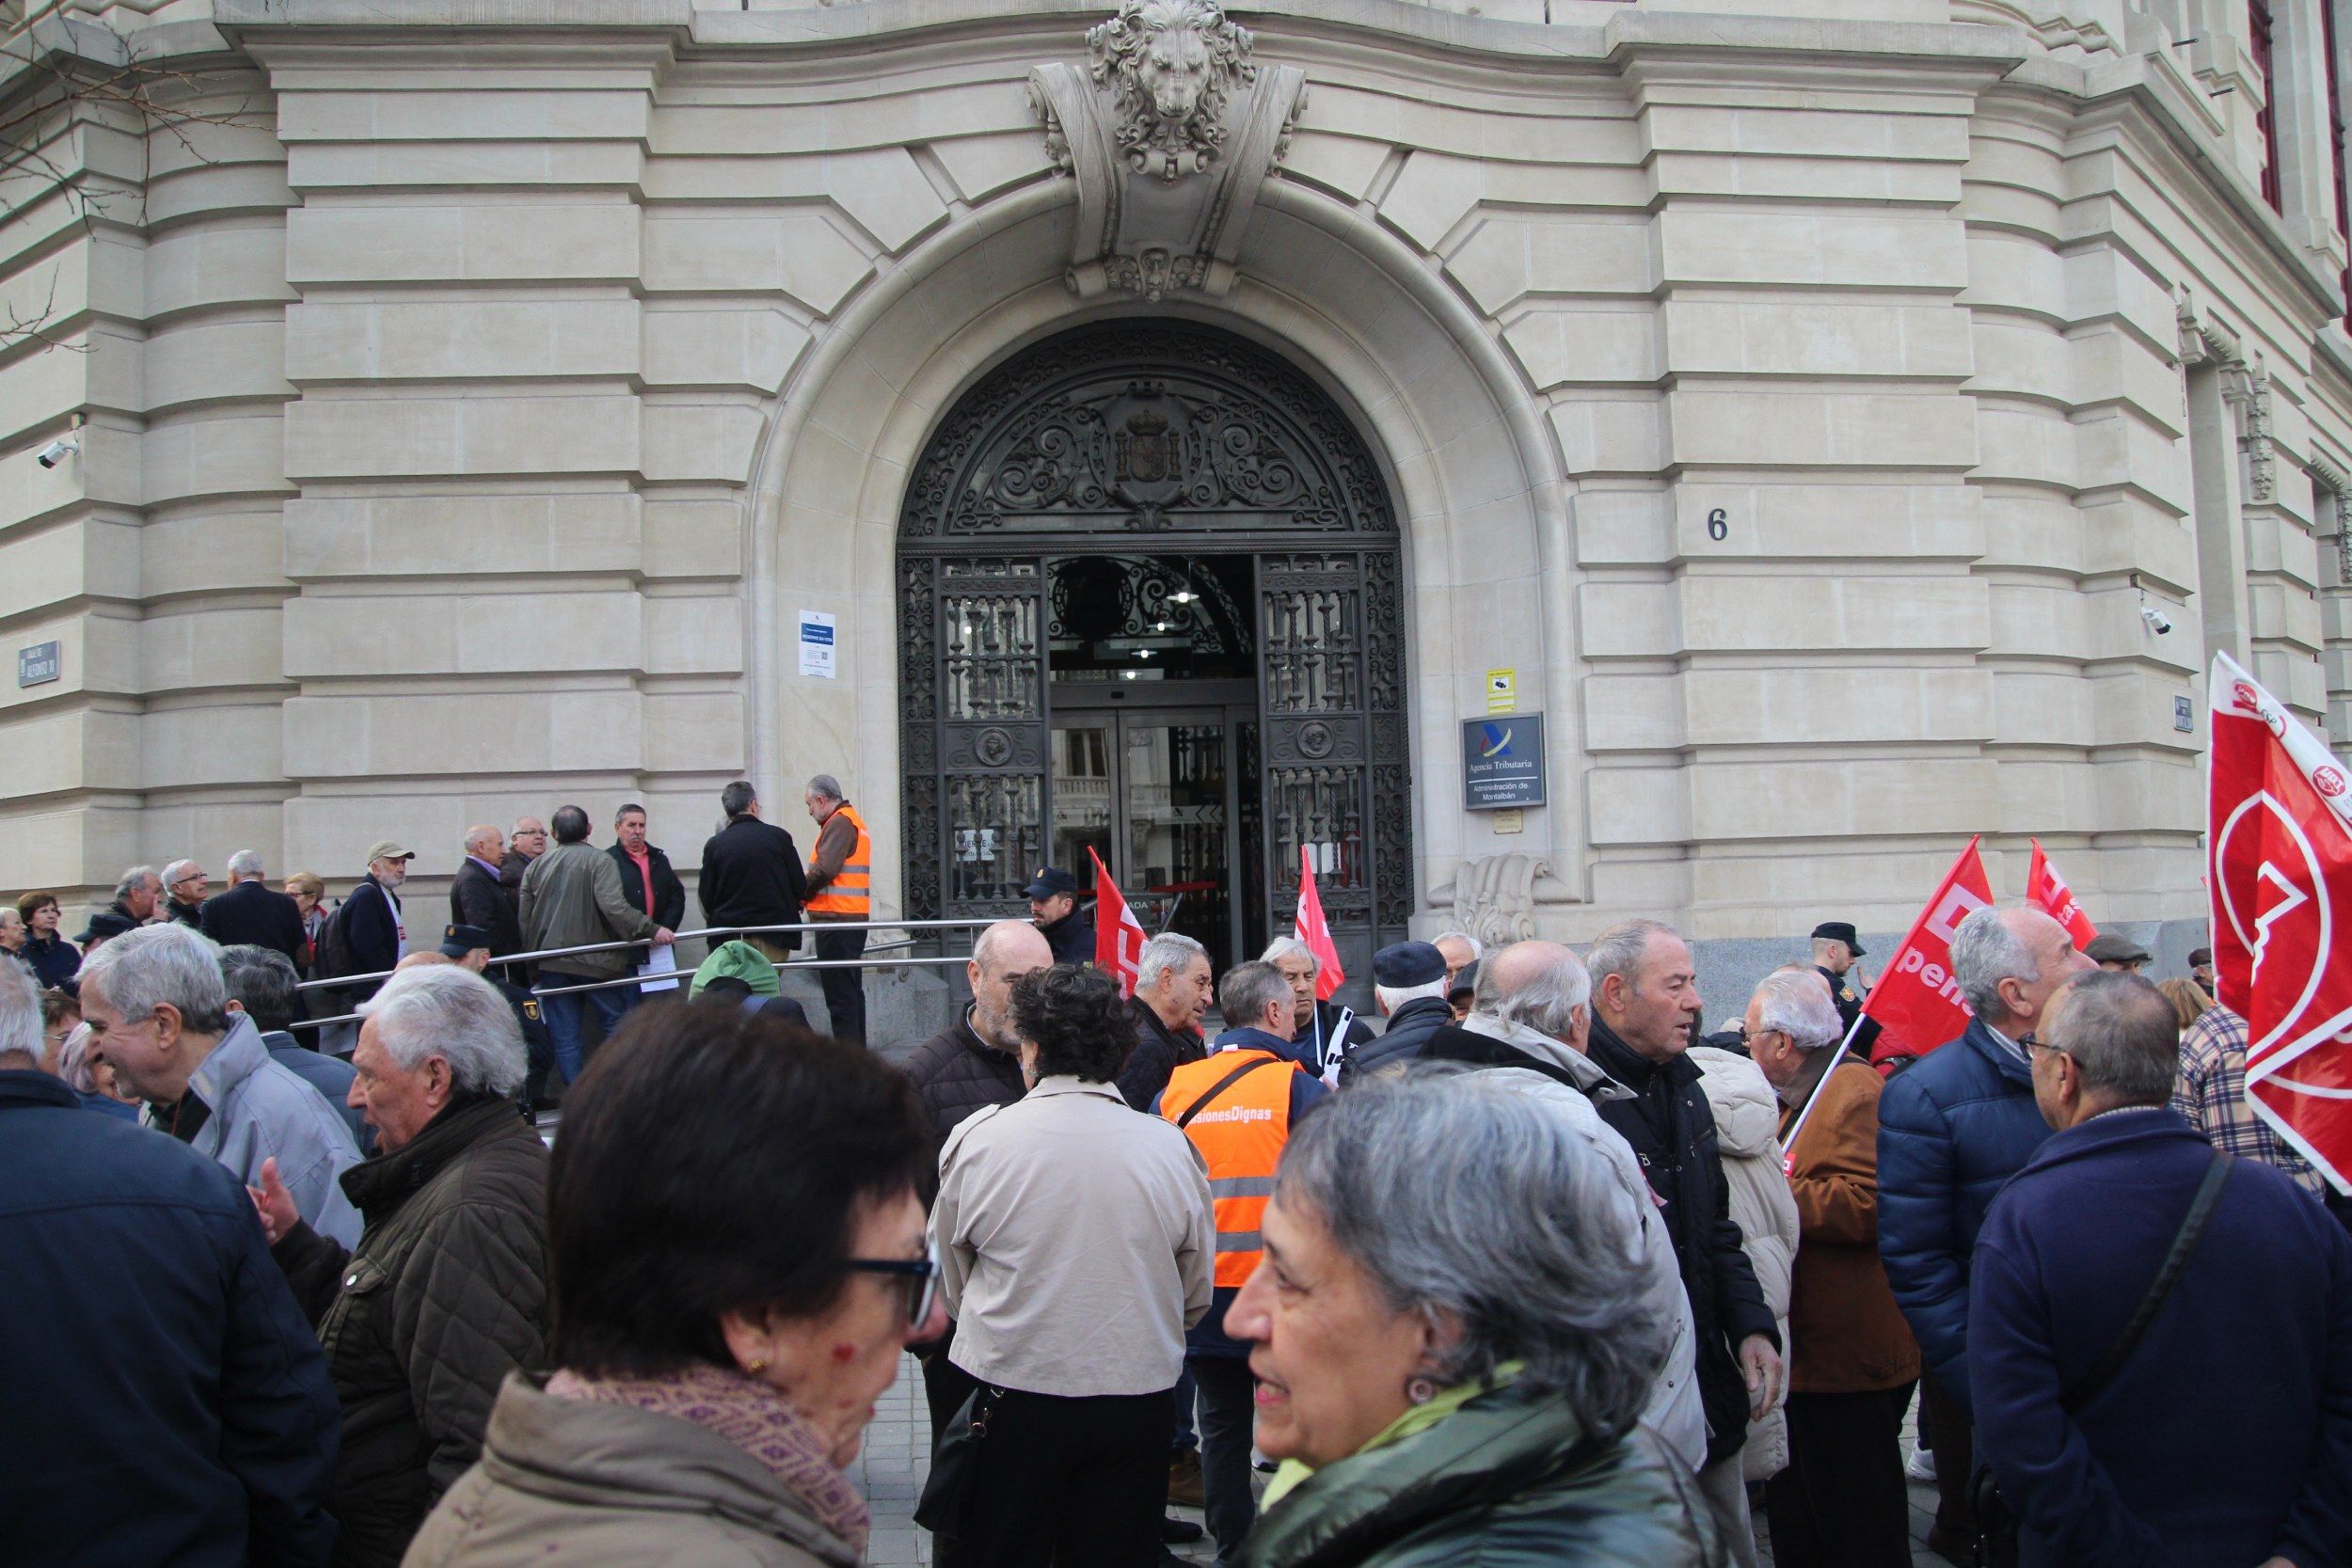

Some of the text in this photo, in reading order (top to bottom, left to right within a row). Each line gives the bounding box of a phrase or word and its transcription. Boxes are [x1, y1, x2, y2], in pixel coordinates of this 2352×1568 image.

[1708, 508, 1727, 541] 6
[1469, 759, 1533, 773] Agencia Tributaria
[1473, 783, 1518, 792] Administración
[1128, 901, 1149, 910] ADA
